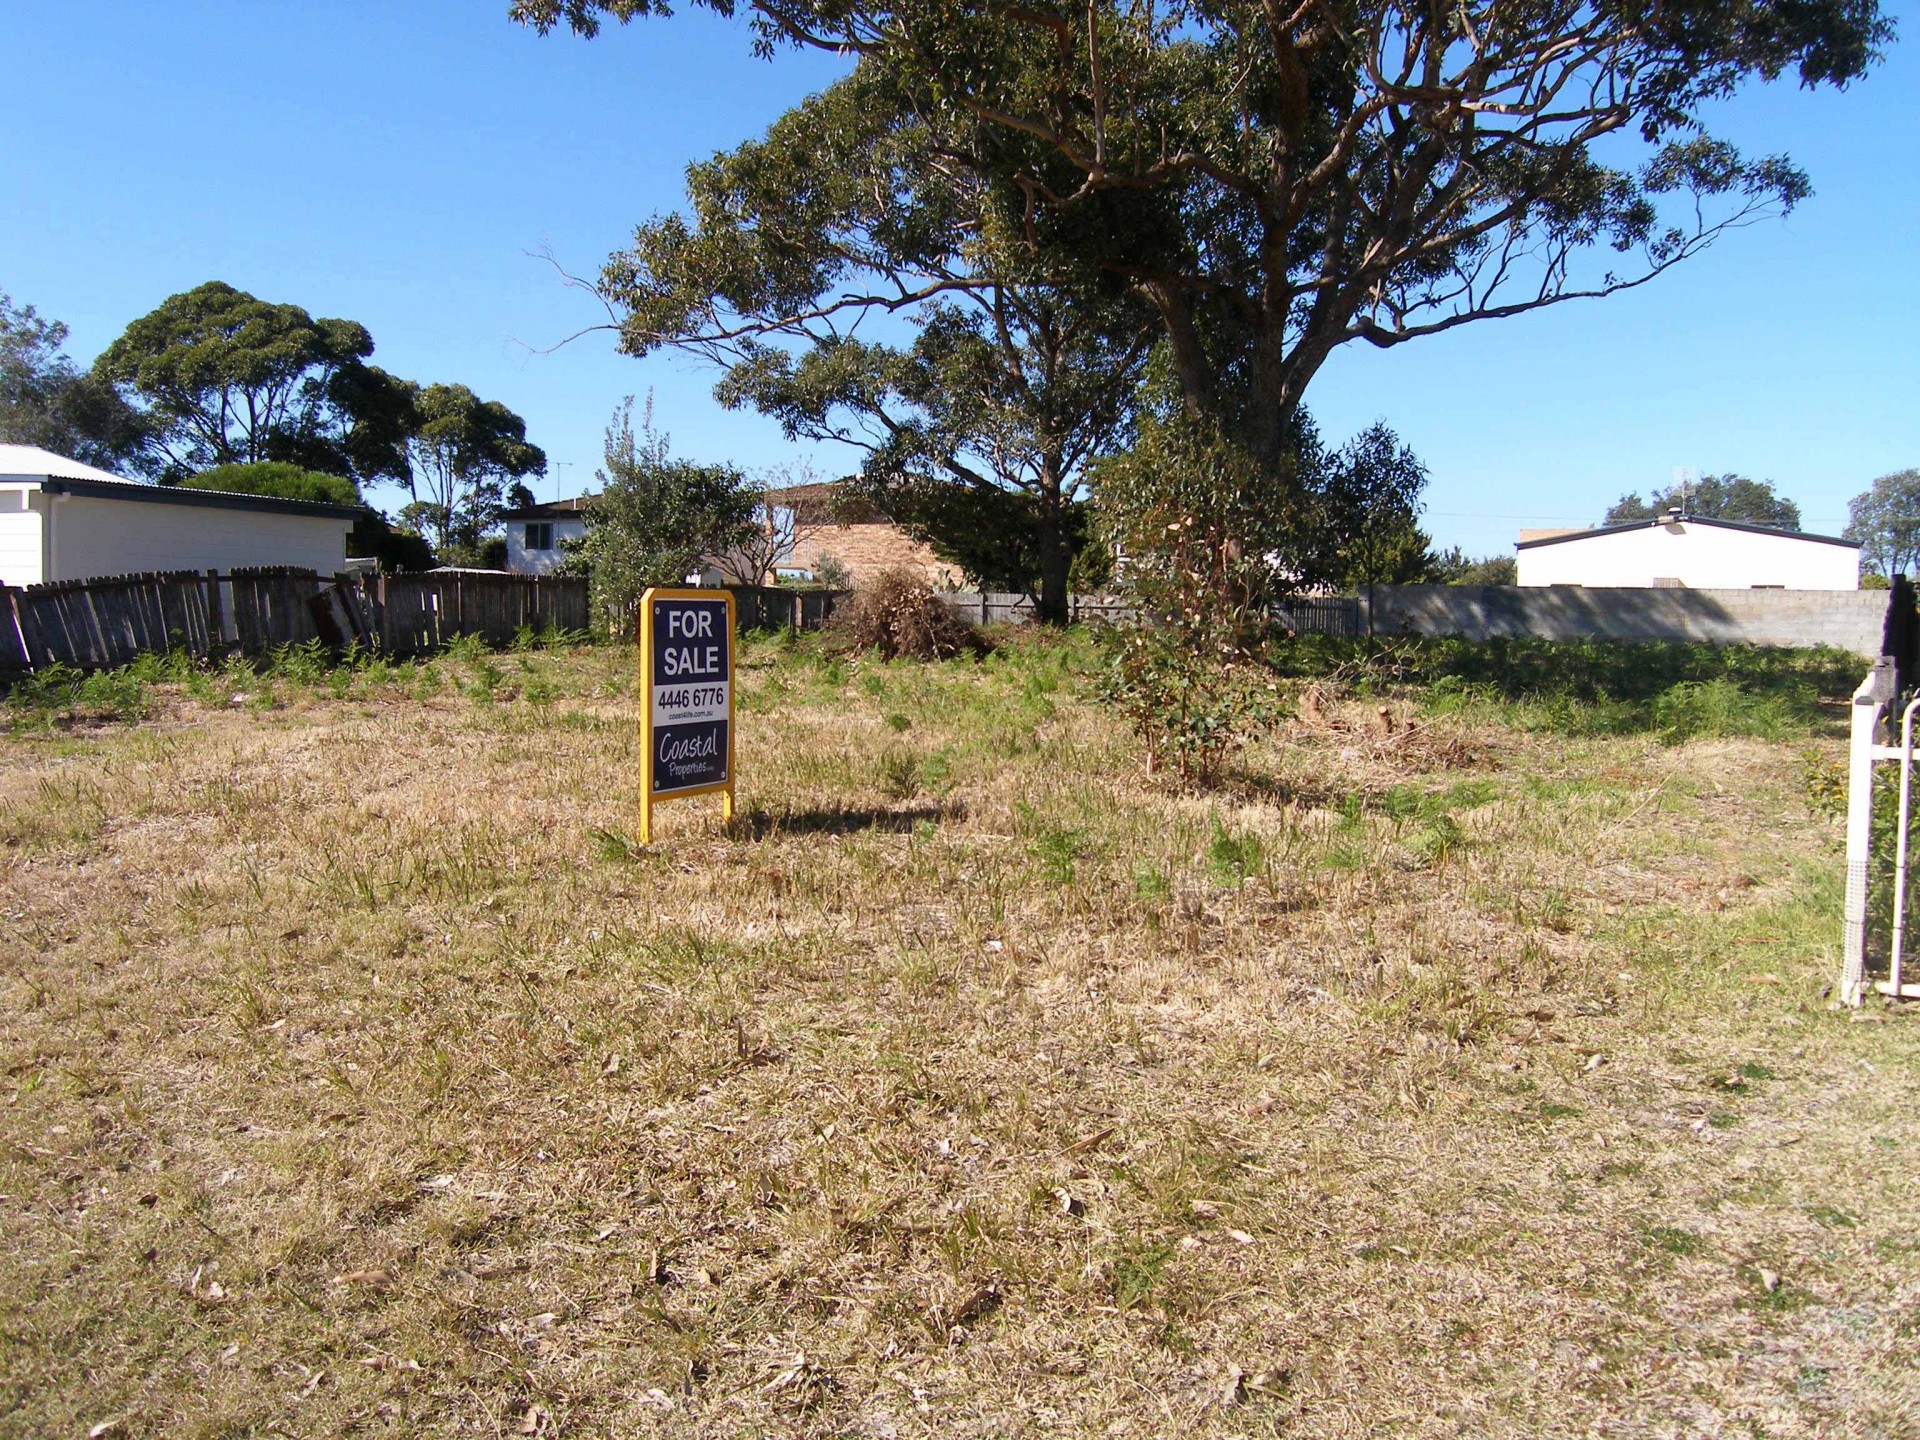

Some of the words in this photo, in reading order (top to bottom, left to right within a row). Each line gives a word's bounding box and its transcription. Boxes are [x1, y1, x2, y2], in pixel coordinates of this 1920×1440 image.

[669, 610, 713, 638] FOR
[664, 646, 719, 676] SALE
[658, 690, 690, 709] 4446
[693, 687, 724, 707] 6776
[660, 728, 718, 763] Coastal
[669, 762, 707, 780] Properties
